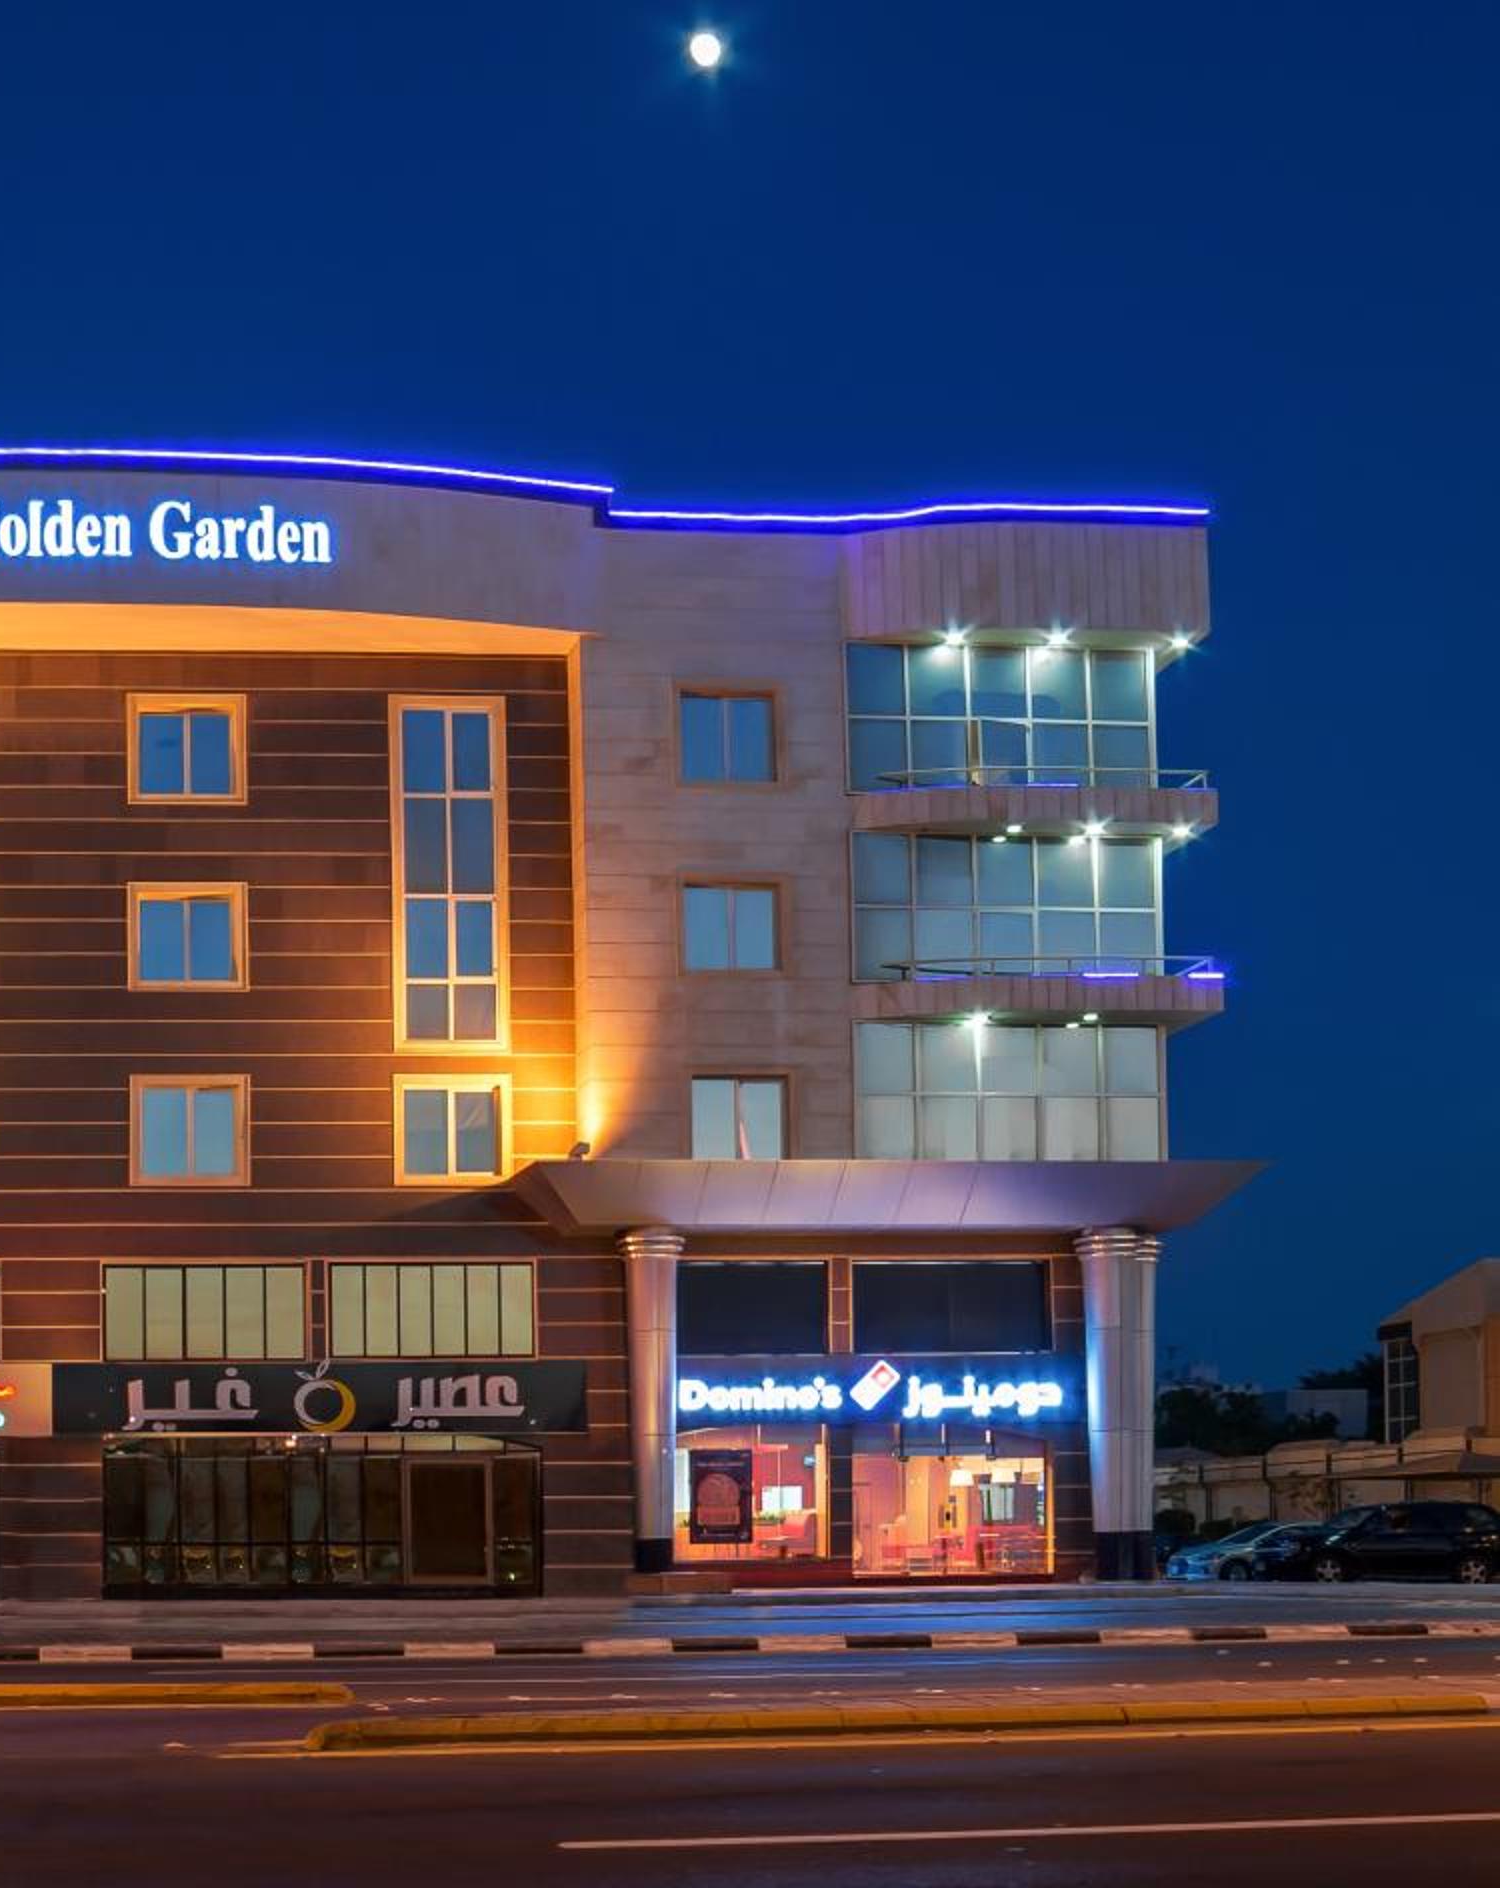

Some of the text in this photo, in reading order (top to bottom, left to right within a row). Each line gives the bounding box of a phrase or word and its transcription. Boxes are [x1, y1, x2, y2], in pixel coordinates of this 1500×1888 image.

[149, 501, 331, 563] Garden
[121, 1367, 525, 1432] عصير غير
[678, 1376, 843, 1411] Domino's
[902, 1375, 1062, 1418] دومينوز
